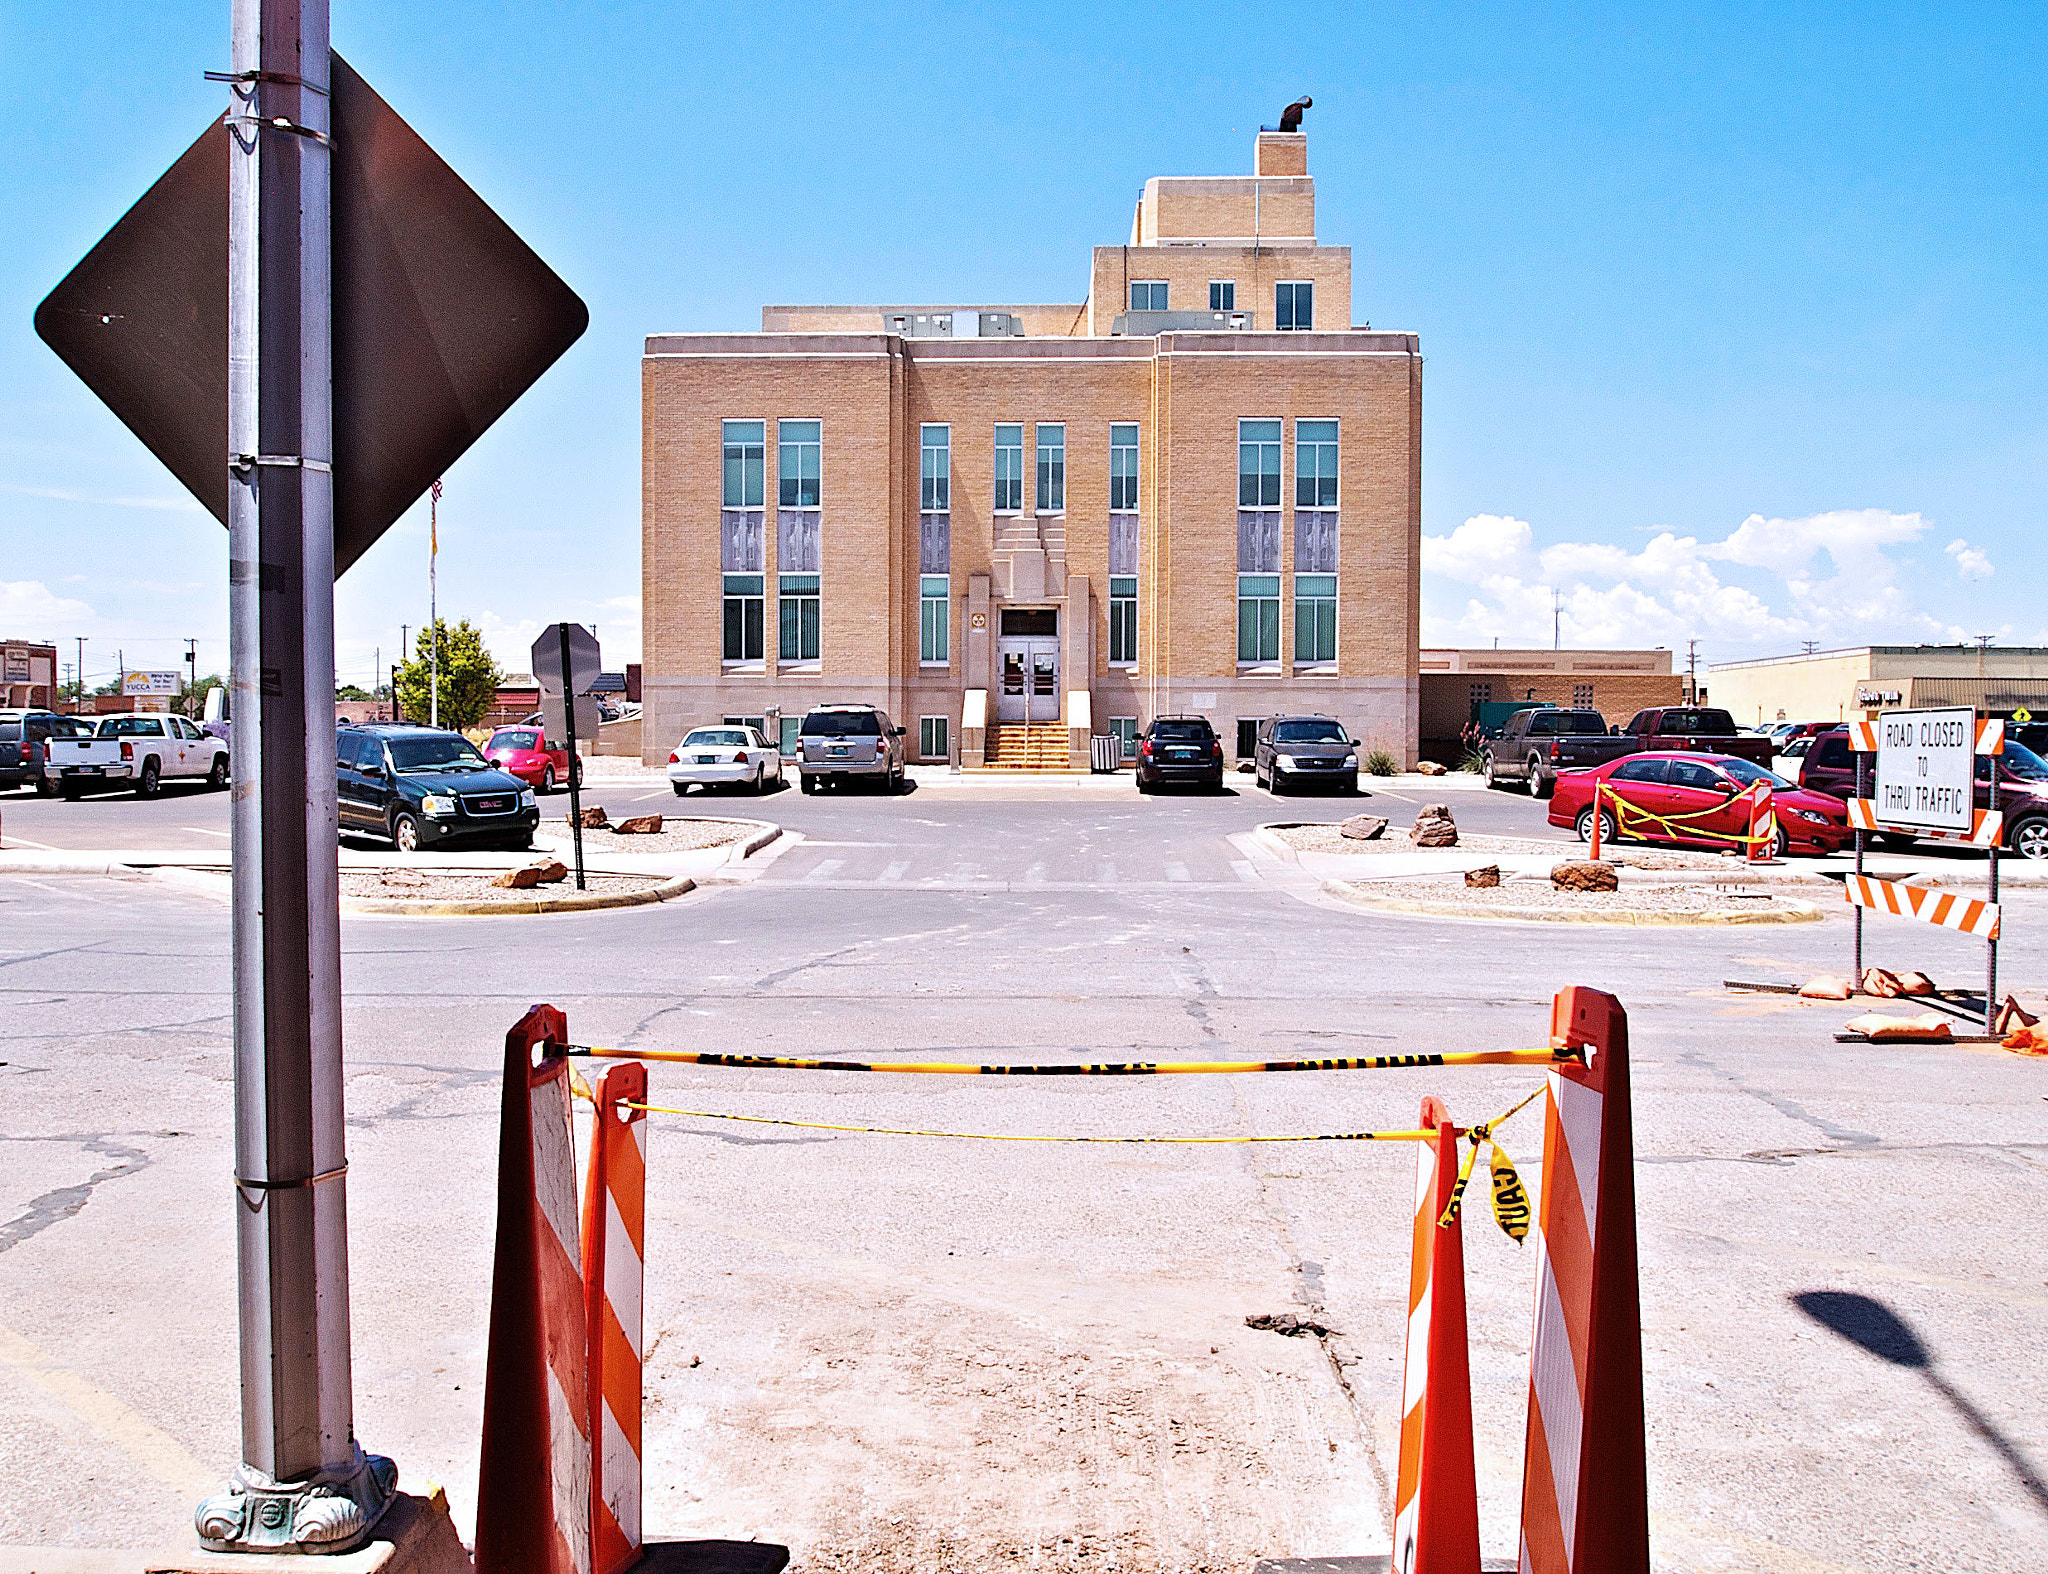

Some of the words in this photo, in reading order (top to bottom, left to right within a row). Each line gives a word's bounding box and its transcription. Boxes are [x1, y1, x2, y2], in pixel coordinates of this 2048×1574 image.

[1886, 723, 1913, 748] ROAD
[1920, 721, 1964, 748] CLOSED
[1918, 756, 1928, 777] TO
[479, 800, 503, 809] GMC
[1885, 784, 1911, 810] THRU
[1916, 786, 1962, 815] TRAFFIC
[1493, 1168, 1529, 1243] CAUT
